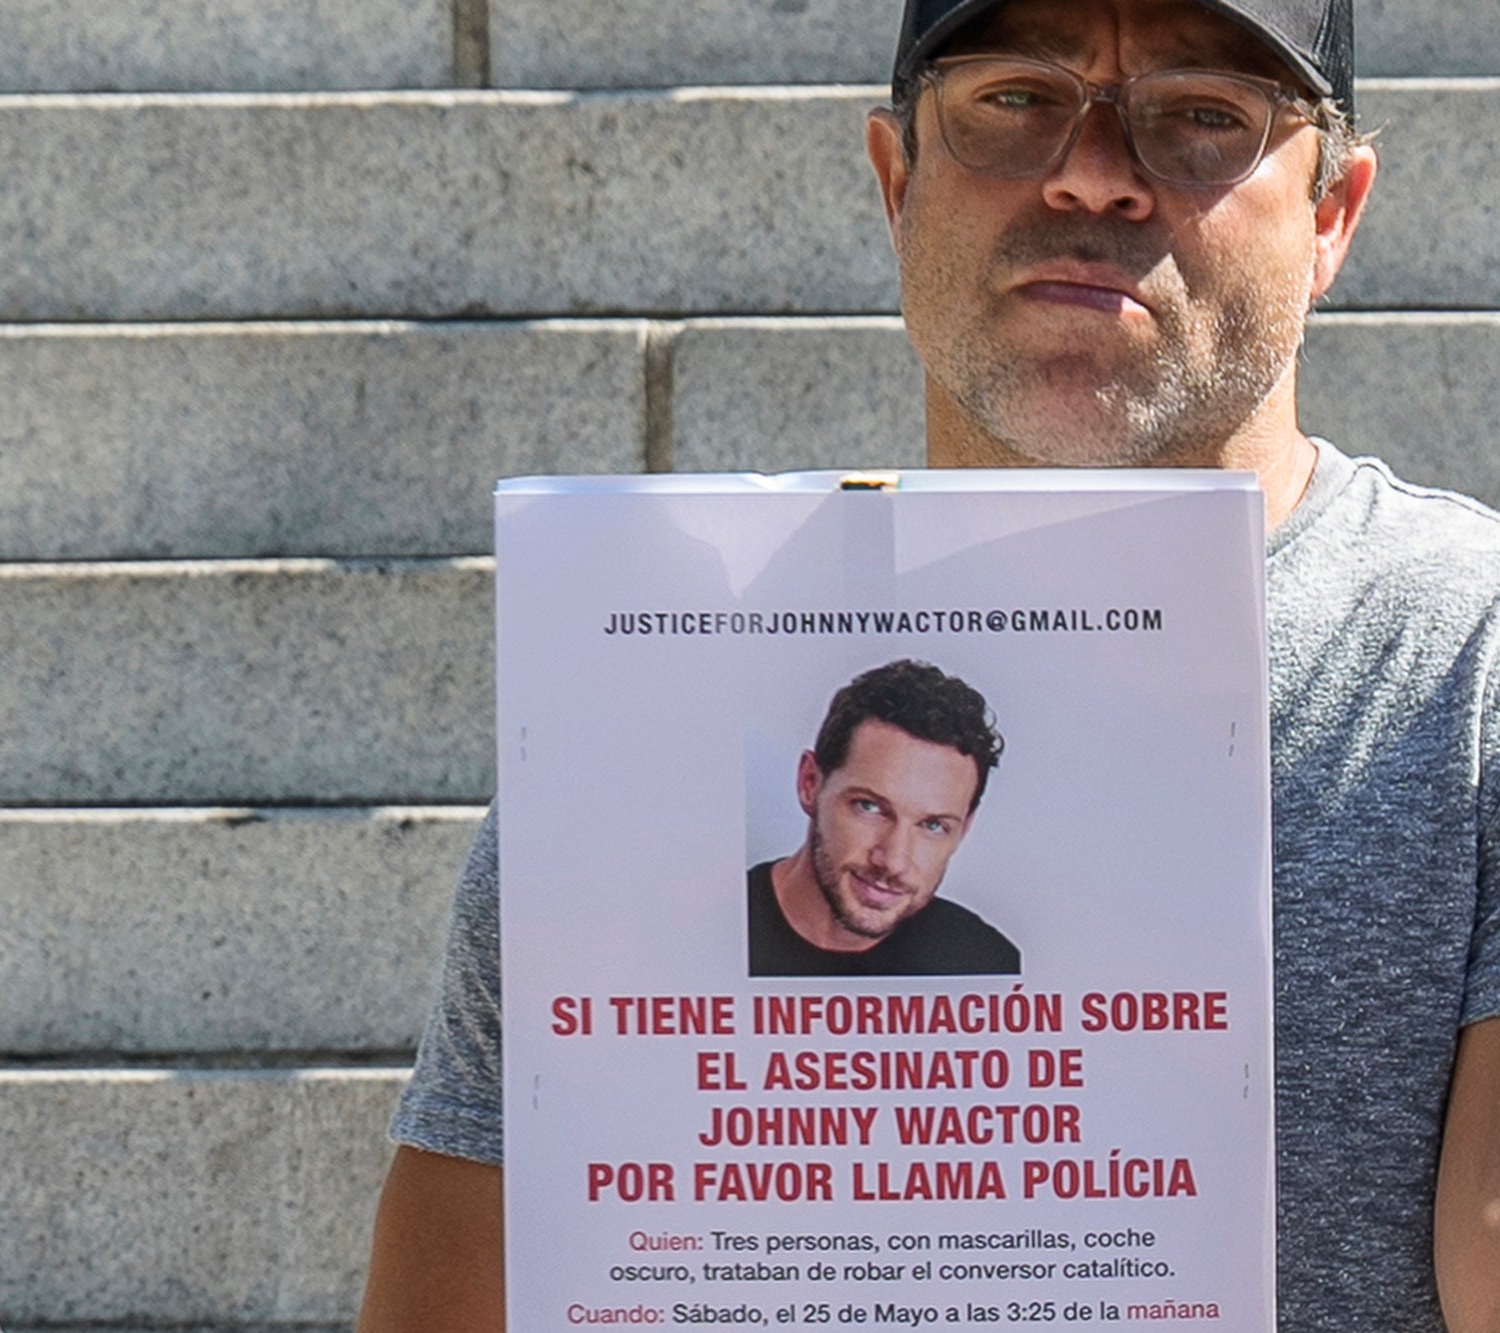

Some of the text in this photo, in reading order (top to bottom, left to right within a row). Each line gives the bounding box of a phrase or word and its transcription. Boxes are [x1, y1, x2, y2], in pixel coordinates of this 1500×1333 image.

[604, 608, 1162, 635] JUSTICEFORJOHNNYWACTOR@GMAIL.COM
[551, 983, 1228, 1036] SI TIENE INFORMACIÓN SOBRE
[697, 1049, 1084, 1091] EL ASESINATO DE
[698, 1104, 1081, 1147] JOHNNY WACTOR
[588, 1148, 1197, 1202] POR FAVOR LLAMA POLÍCIA
[629, 1227, 1156, 1255] Quien: Tres personas, con mascarillas, coche
[609, 1257, 1175, 1284] oscuro, trataban de robar el conversor catalítico.
[567, 1299, 1220, 1328] Cuando: Sábado, el 25 de Mayo a las 3:25 de la mañana
